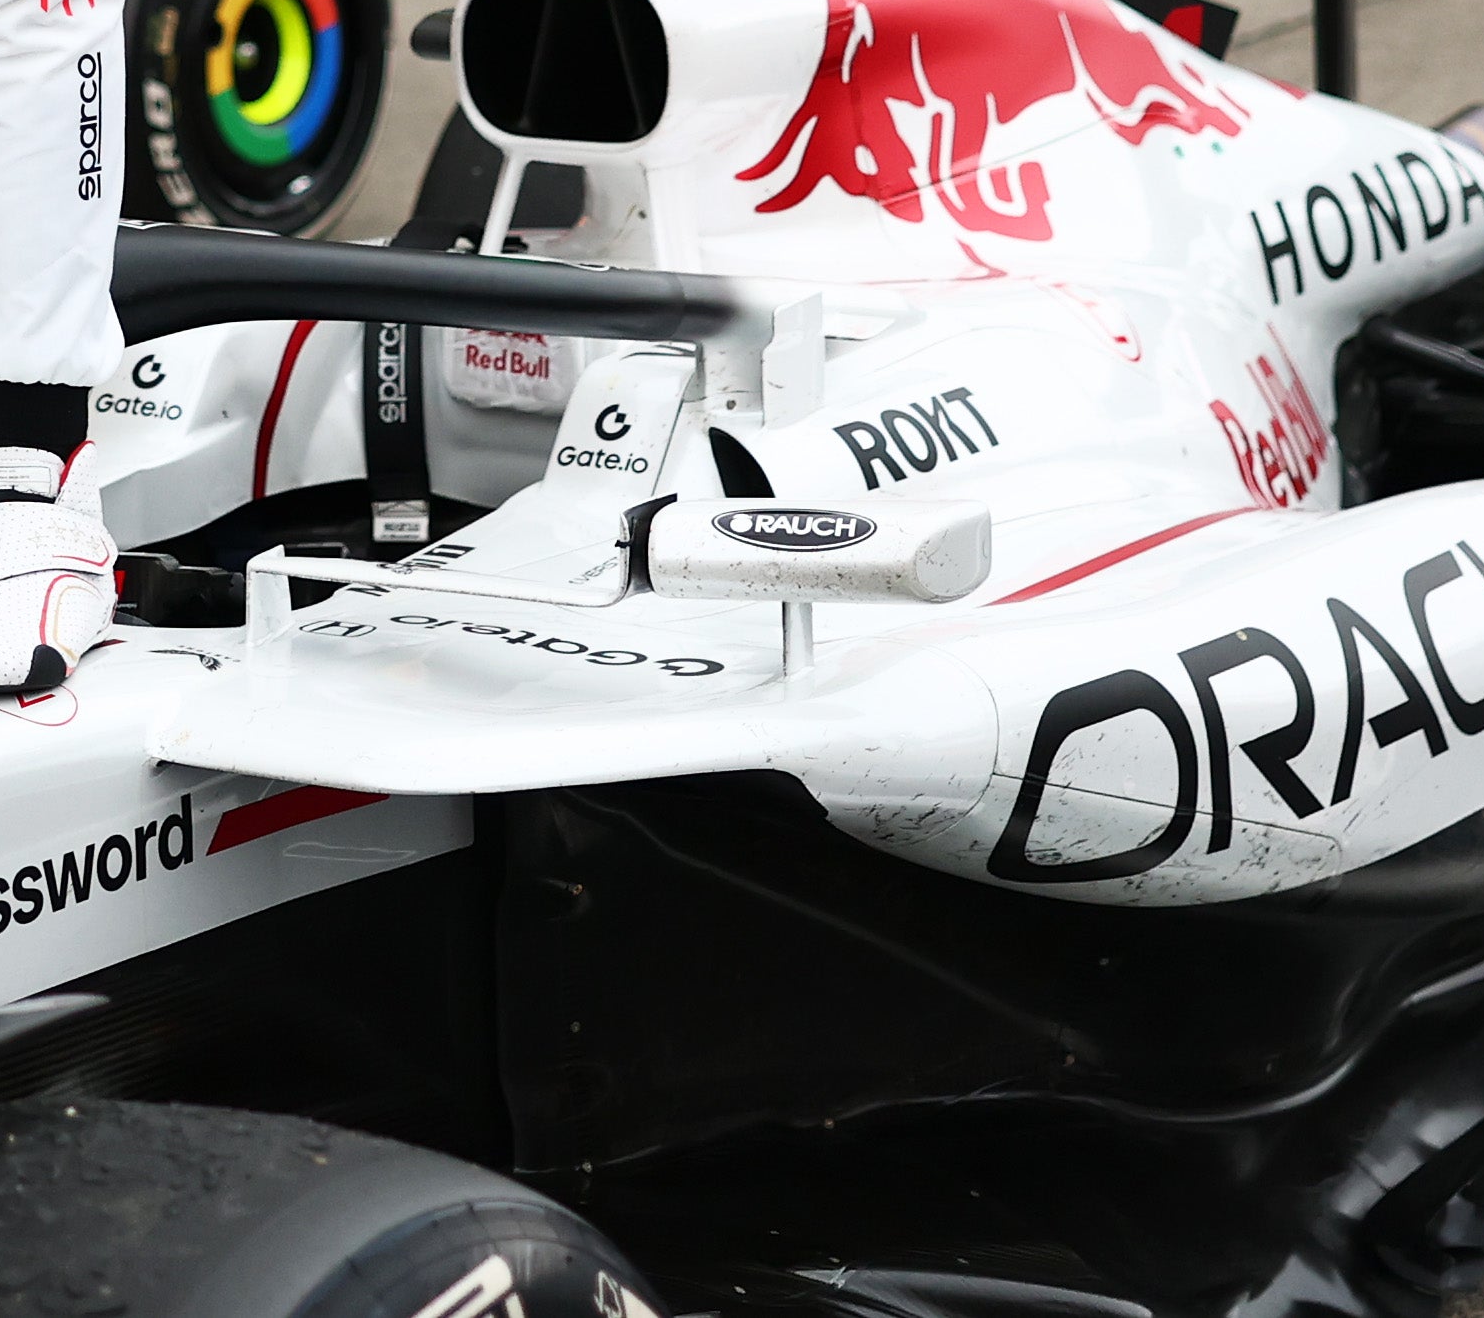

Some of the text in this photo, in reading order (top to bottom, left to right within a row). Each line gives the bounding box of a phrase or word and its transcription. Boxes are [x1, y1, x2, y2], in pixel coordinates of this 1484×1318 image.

[77, 52, 101, 200] sparco
[465, 343, 551, 380] Red Bull
[95, 391, 183, 422] Gate.io
[557, 446, 649, 475] Gate.io
[754, 511, 862, 541] RAUCH
[390, 613, 649, 666] Gate.io
